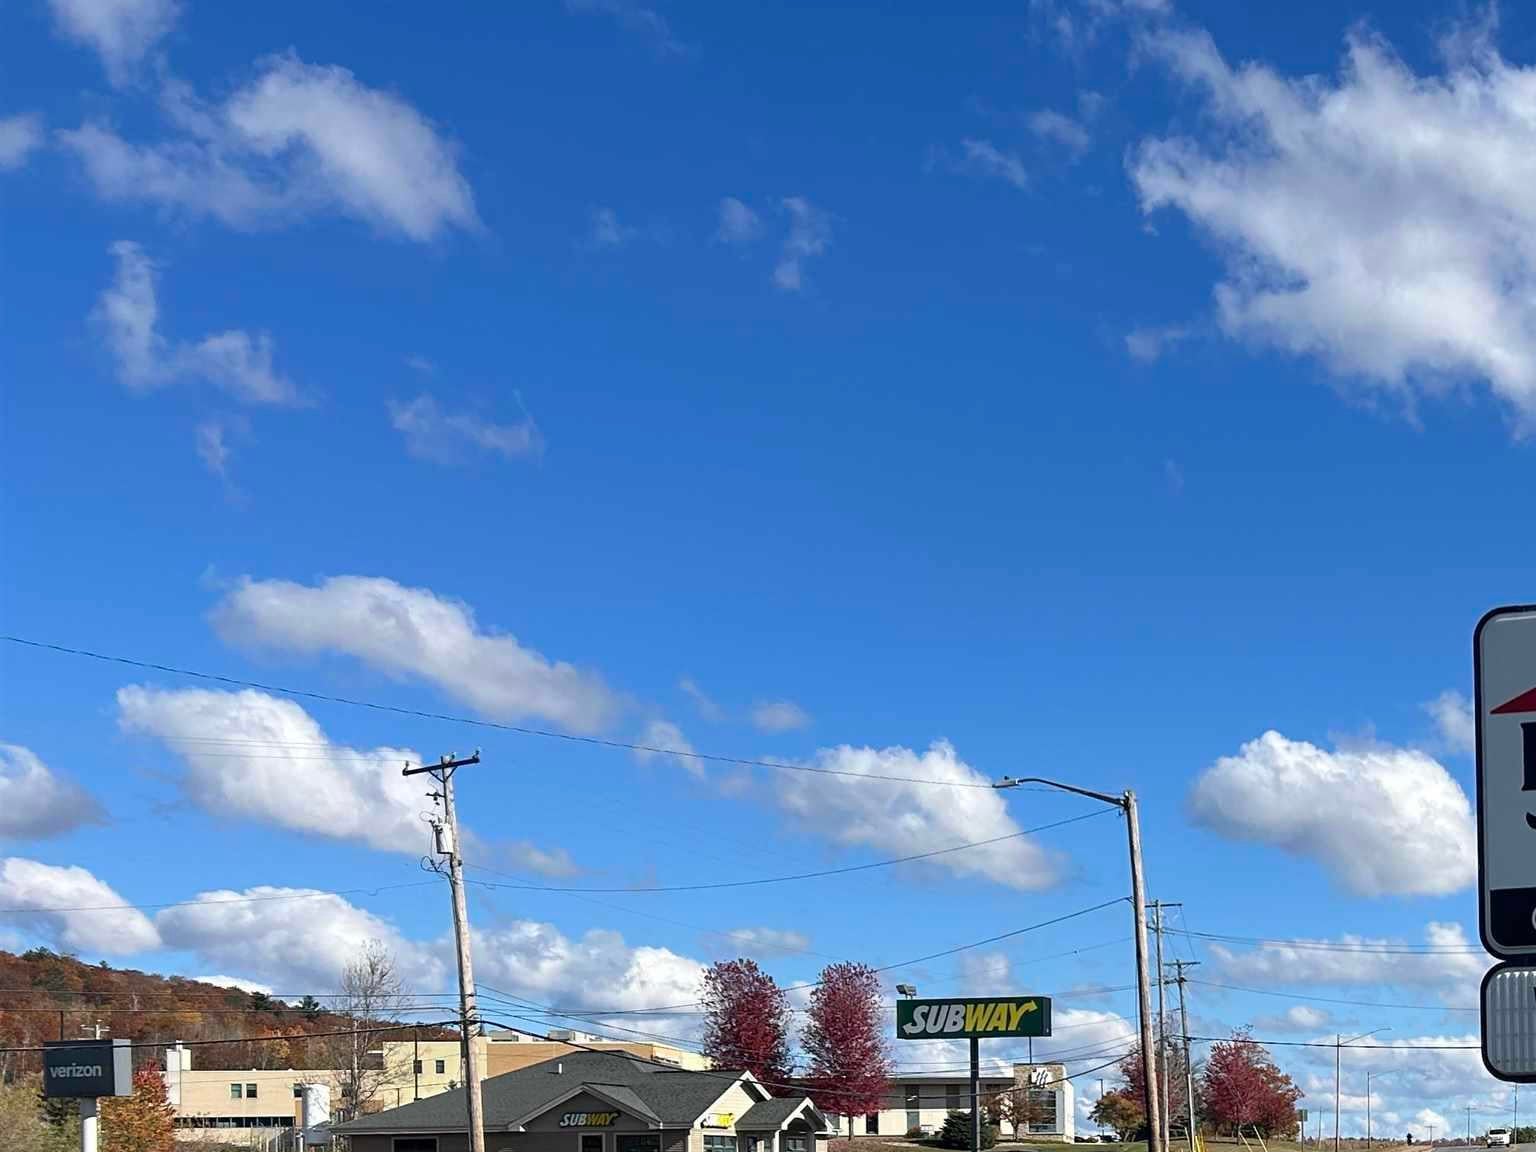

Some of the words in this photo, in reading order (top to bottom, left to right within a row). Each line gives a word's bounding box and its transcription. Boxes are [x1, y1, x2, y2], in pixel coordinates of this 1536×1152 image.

[902, 1000, 1038, 1035] SUBWAY
[50, 1062, 102, 1078] verizon
[559, 1113, 618, 1127] SUBWAY
